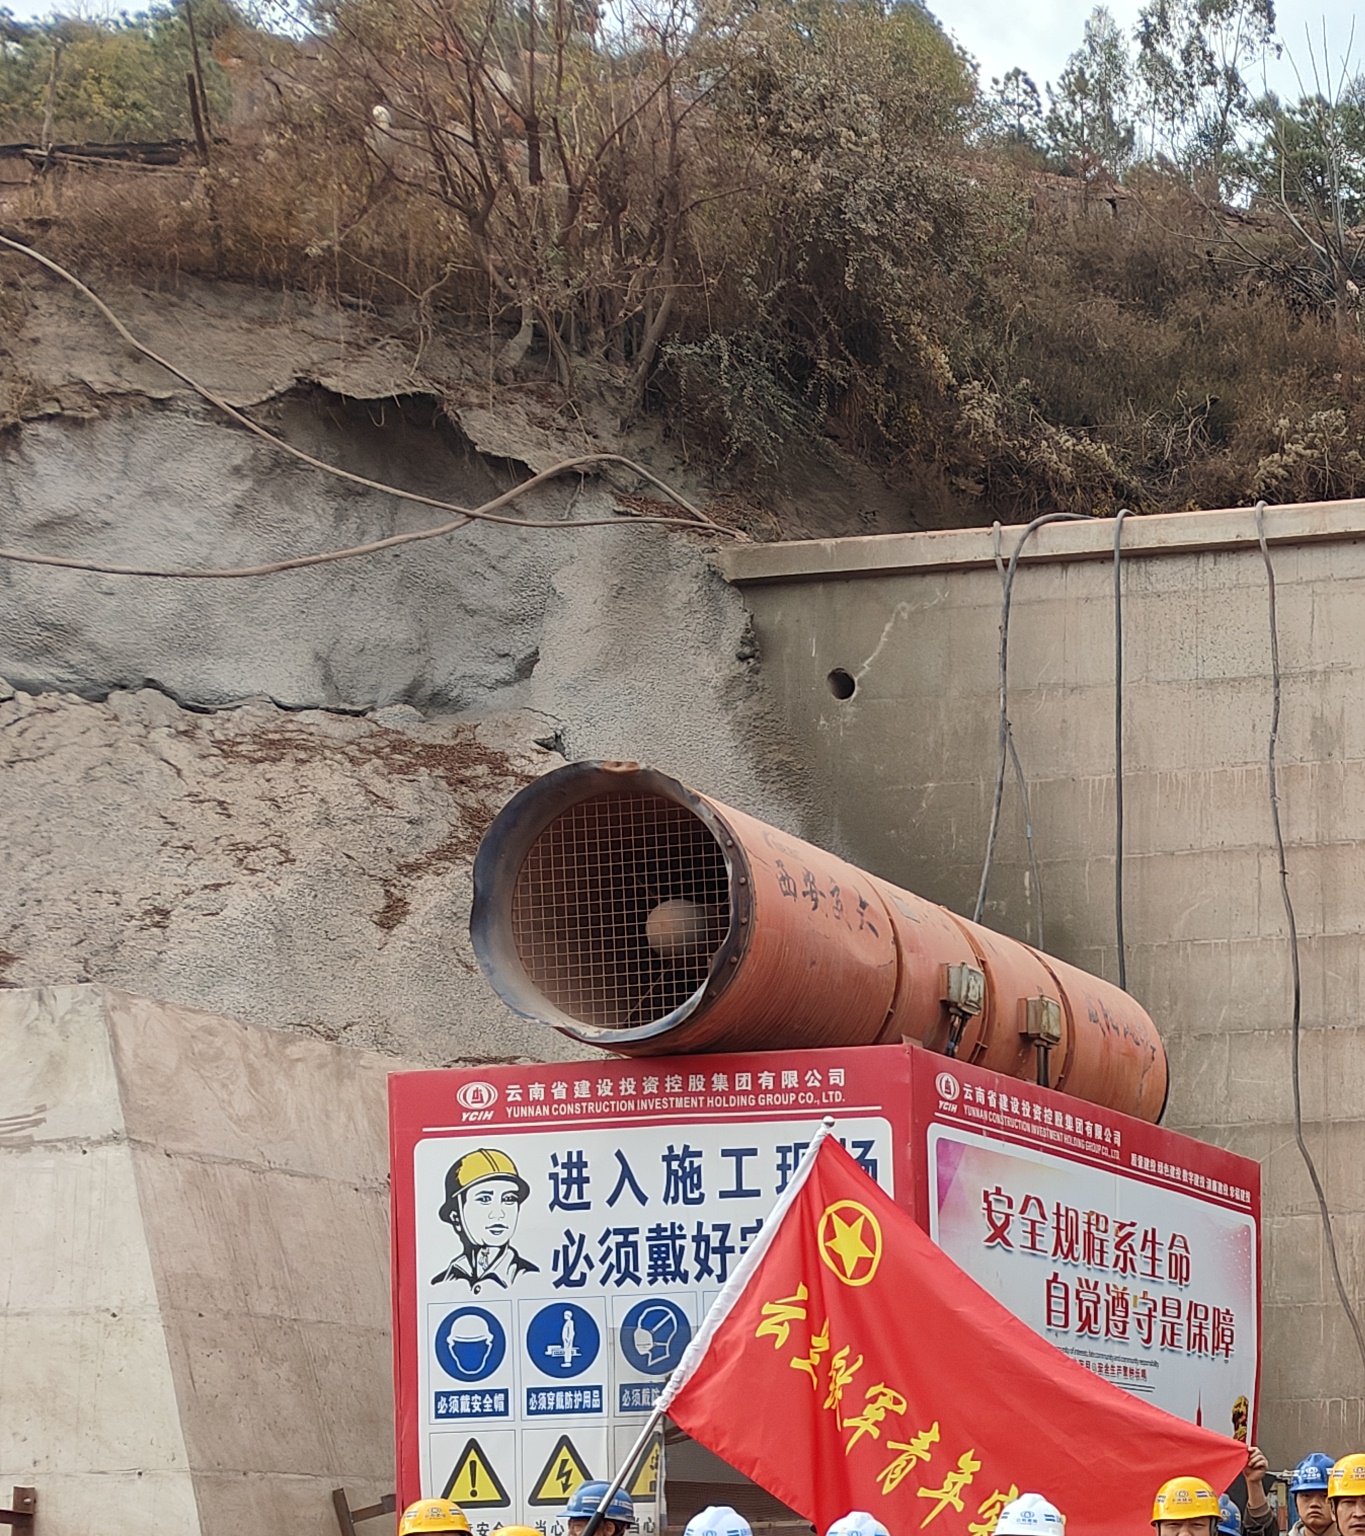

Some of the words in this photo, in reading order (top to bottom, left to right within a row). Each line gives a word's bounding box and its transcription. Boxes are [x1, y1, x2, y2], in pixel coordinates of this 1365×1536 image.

[505, 1068, 846, 1102] 云南省建设投资控股集团有限公司
[461, 1110, 494, 1121] YCIH
[505, 1104, 550, 1118] YUNNAN
[551, 1100, 635, 1116] CONSTRUCTION
[636, 1096, 705, 1111] INVESTMENT
[706, 1095, 756, 1108] HOLDING
[757, 1093, 796, 1106] GROUP
[938, 1100, 958, 1113] YCIH
[962, 1083, 1122, 1148] 云南省建设投资控股集团有限公司
[981, 1185, 1191, 1287] 安全规程系生命
[1044, 1271, 1236, 1361] 自觉遵守是保障
[436, 1392, 506, 1415] 必须戴安全帽
[528, 1388, 601, 1411] 必须穿戴防护用品
